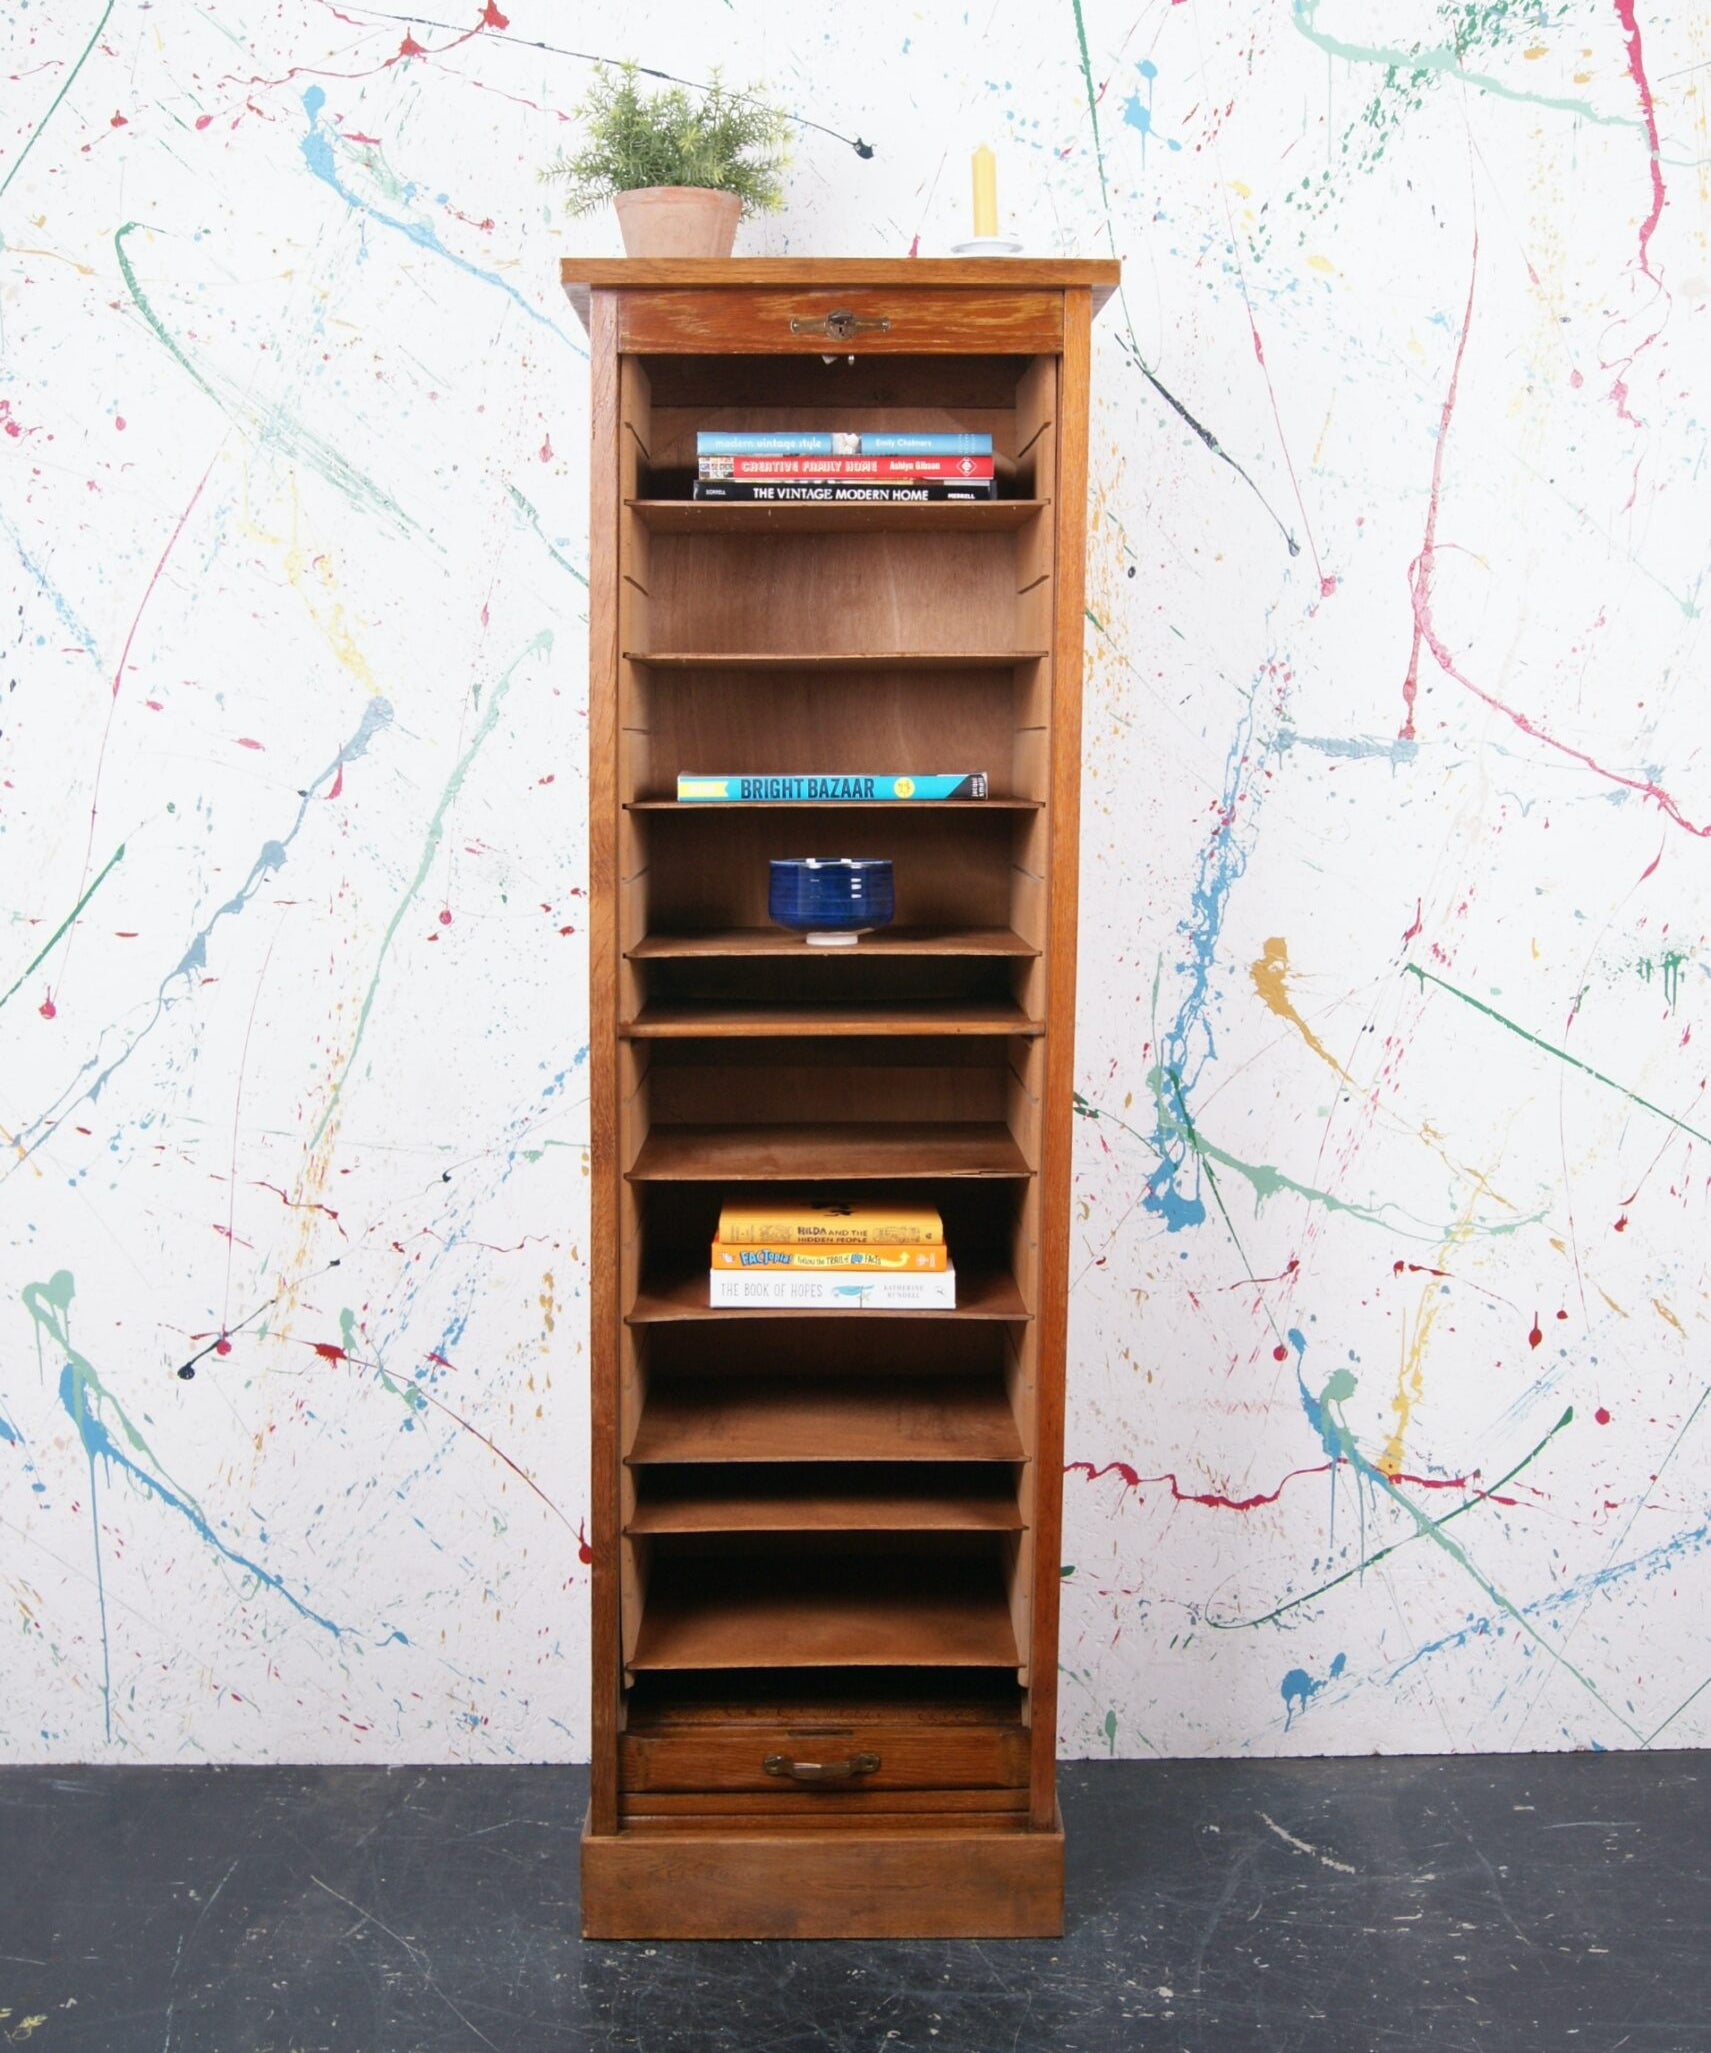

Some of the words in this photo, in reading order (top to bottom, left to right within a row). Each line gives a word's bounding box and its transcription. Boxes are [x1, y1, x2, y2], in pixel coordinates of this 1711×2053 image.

[757, 437, 795, 451] vintage
[798, 436, 822, 450] style
[875, 438, 895, 448] Emily
[741, 460, 798, 473] CREATIVE
[845, 460, 878, 473] HOME
[753, 487, 775, 499] THE
[776, 487, 833, 500] VINTAGE
[835, 488, 889, 501] MODERN
[892, 489, 929, 502] HOME
[740, 778, 804, 799] BRIGHT
[807, 778, 875, 799] BAZAAR
[797, 1226, 826, 1236] HILDA
[828, 1229, 849, 1237] AND
[851, 1229, 868, 1237] THE
[721, 1283, 739, 1297] THE
[744, 1283, 769, 1297] BOOK
[774, 1283, 786, 1297] OF
[791, 1283, 823, 1298] HOPES
